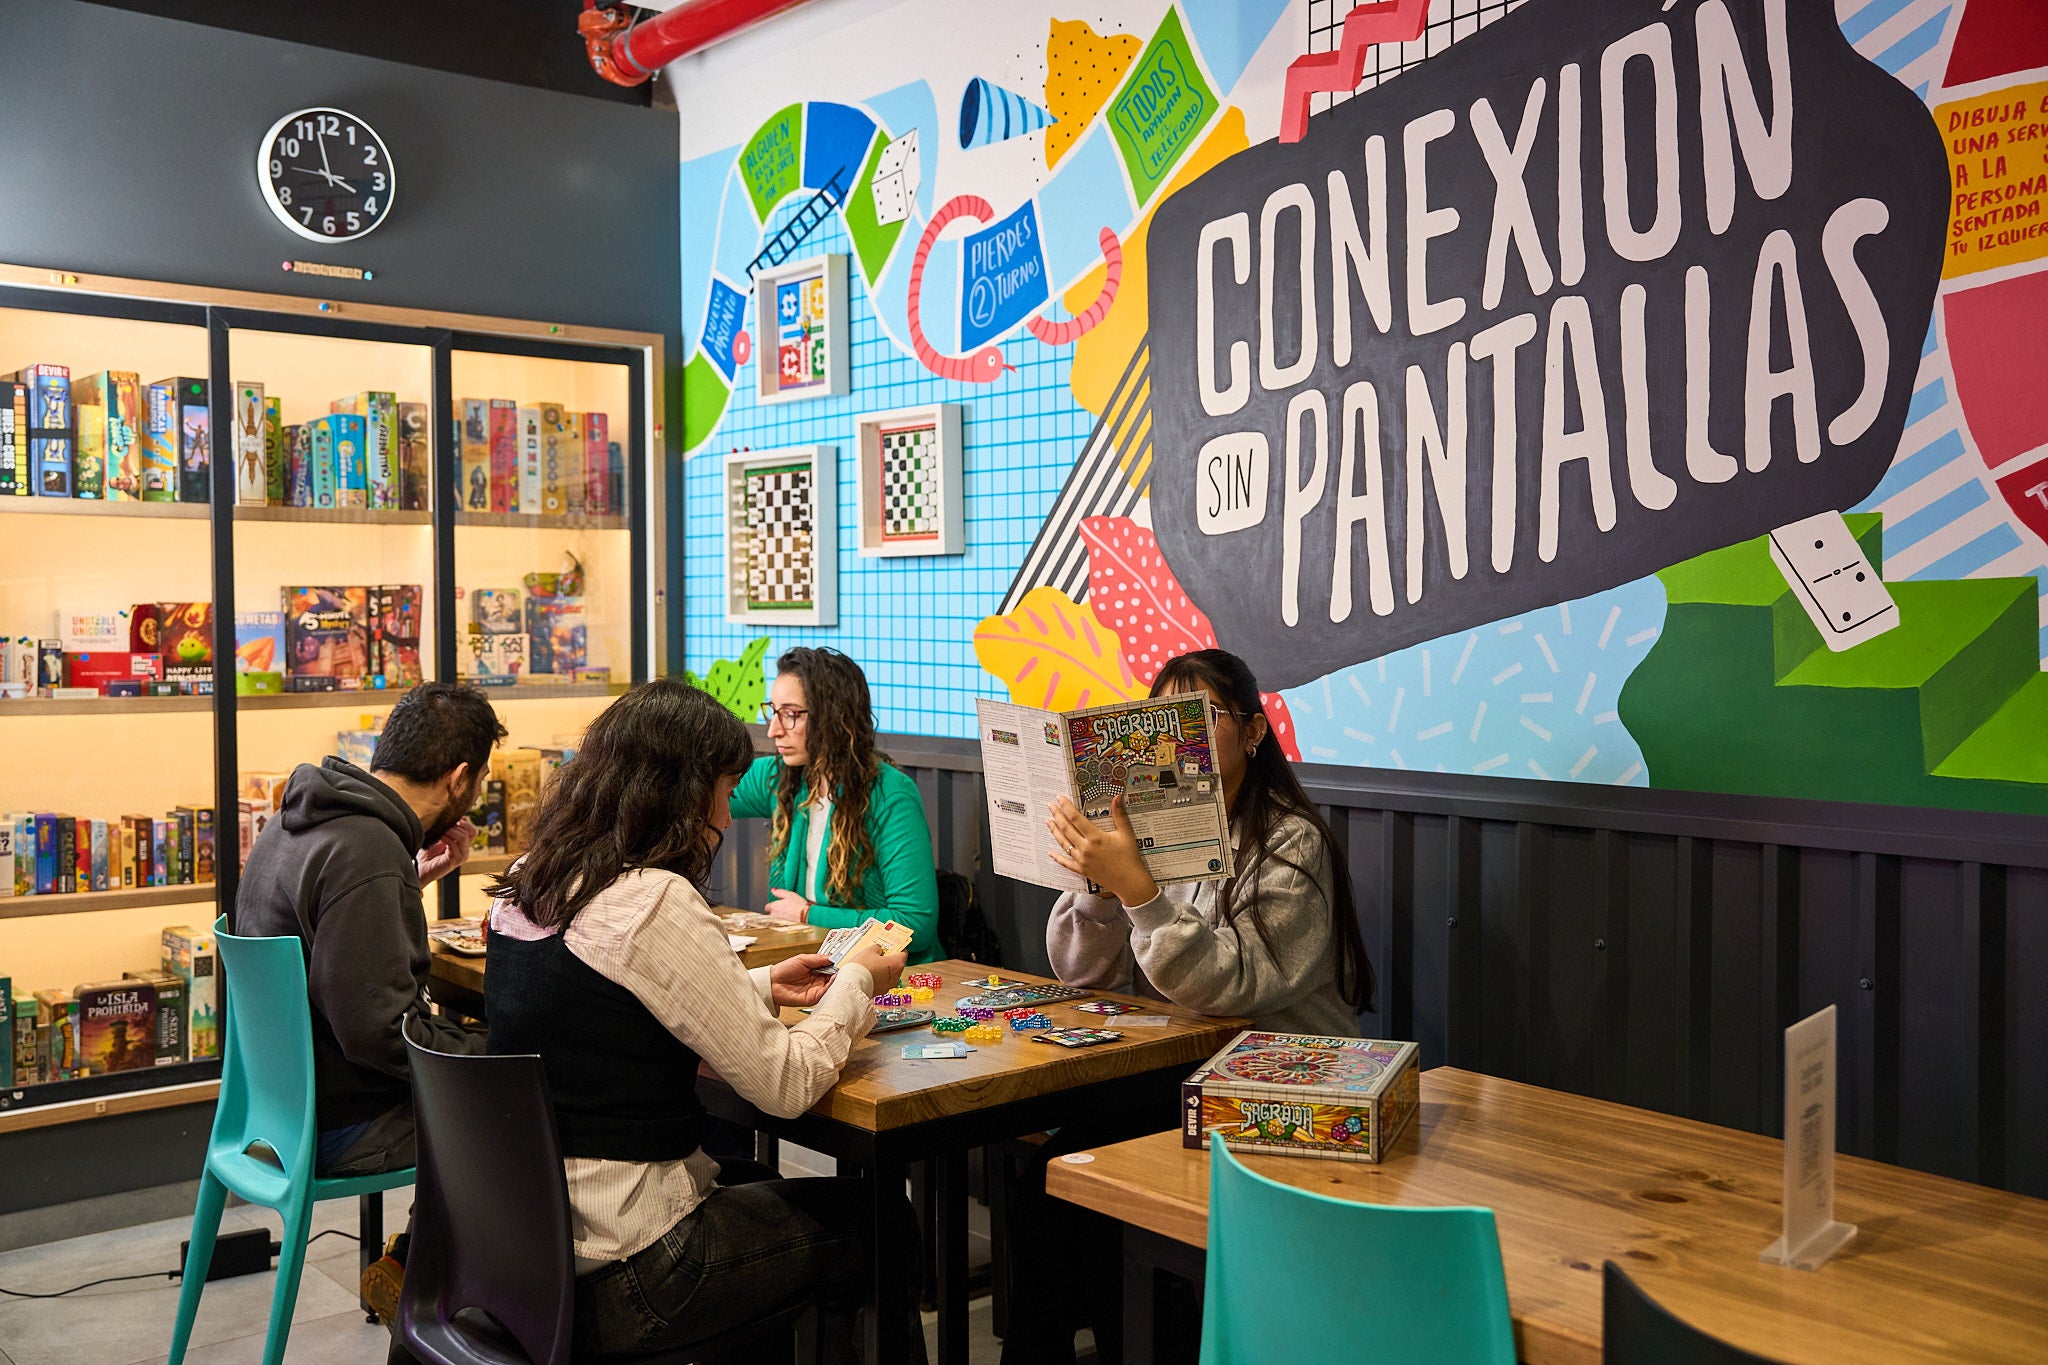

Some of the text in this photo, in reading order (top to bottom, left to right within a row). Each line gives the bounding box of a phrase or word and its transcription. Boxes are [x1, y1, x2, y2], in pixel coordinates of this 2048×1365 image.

[1121, 56, 1176, 133] TODOS
[1142, 86, 1182, 142] APAGAN
[1949, 101, 2027, 133] DIBUJA
[295, 120, 313, 141] 11
[317, 115, 340, 136] 12
[346, 126, 356, 146] 1
[278, 137, 300, 158] 10
[746, 117, 790, 176] ALGUIEN
[1954, 132, 1999, 155] UNA
[363, 145, 378, 166] 2
[270, 159, 283, 179] 9
[1956, 155, 2007, 188] A LA
[372, 172, 386, 191] 3
[280, 186, 292, 205] 8
[364, 196, 378, 216] 4
[1956, 174, 2048, 217] PERSONA
[300, 207, 313, 226] 7
[1198, 0, 1793, 416] CONEXIÓN
[1952, 200, 2040, 237] SENTADA
[322, 216, 336, 235] 6
[346, 211, 360, 231] 5
[972, 215, 1031, 279] PIERDES
[972, 255, 1040, 324] 2 TURNOS
[714, 294, 737, 361] PRONTO
[38, 365, 62, 377] DEVIR
[1208, 198, 1889, 626] SIN PANTALLAS
[1093, 707, 1186, 757] SAGRADA
[107, 991, 139, 1005] ISLA
[87, 1002, 149, 1019] PROHIBIDA
[1269, 1034, 1374, 1052] SAGRADA
[1188, 1109, 1197, 1136] DEVIR
[1240, 1100, 1315, 1138] SAGRADA
